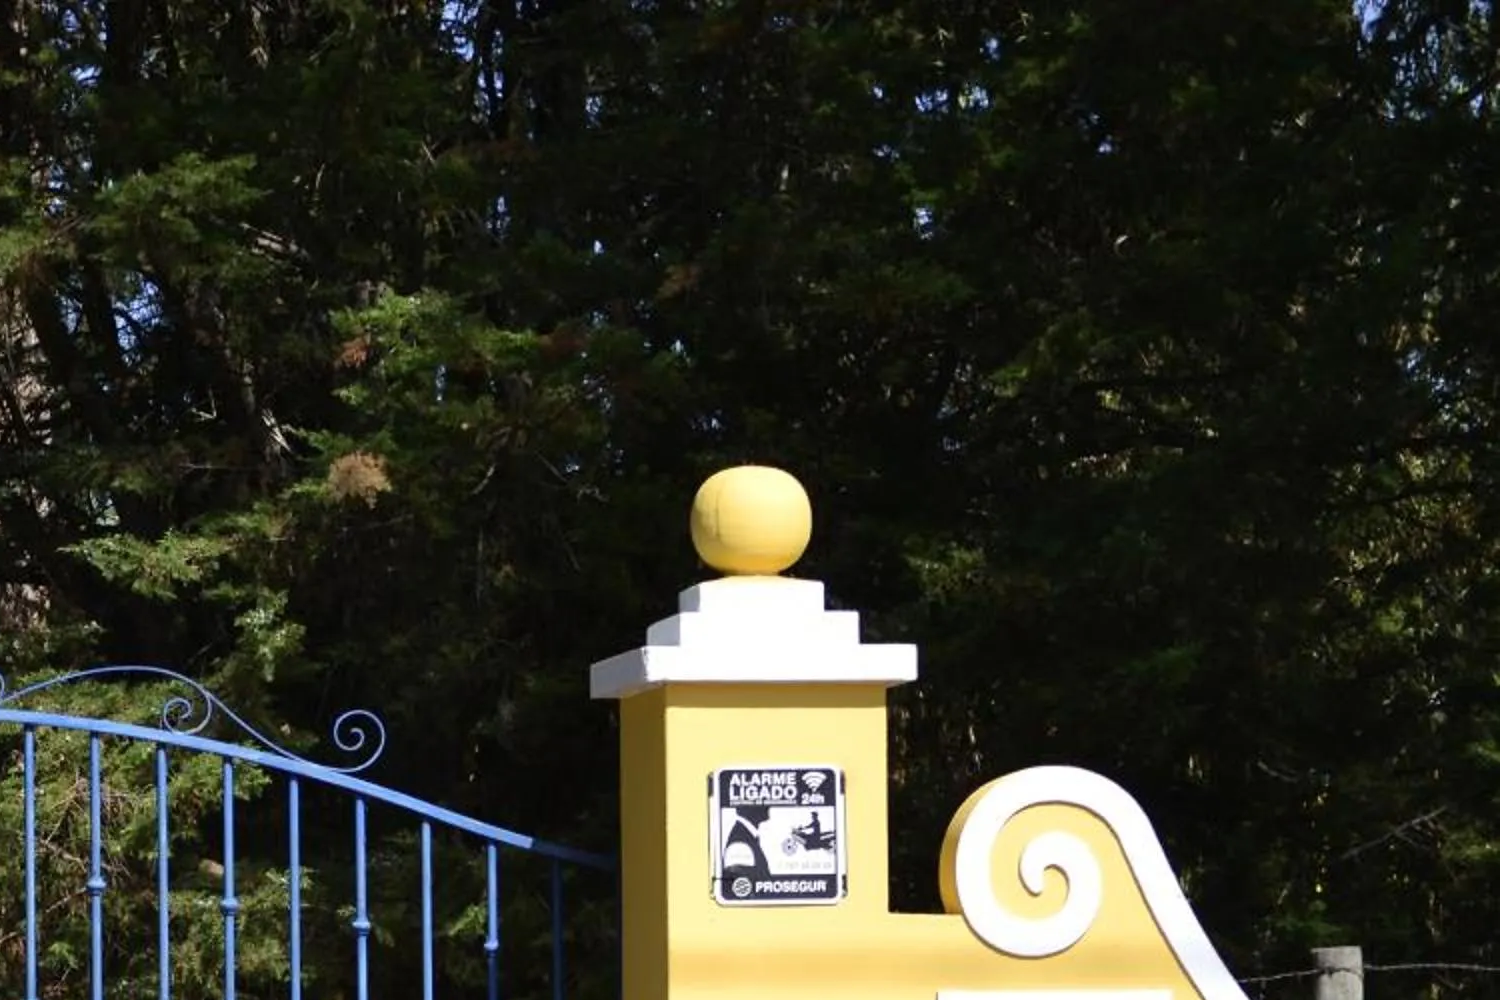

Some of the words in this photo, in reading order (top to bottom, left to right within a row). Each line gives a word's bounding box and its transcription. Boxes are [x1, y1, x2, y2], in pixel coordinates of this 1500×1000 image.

[730, 772, 797, 785] ALARME
[729, 785, 798, 801] LIGADO
[755, 880, 827, 893] PROSEGUR
